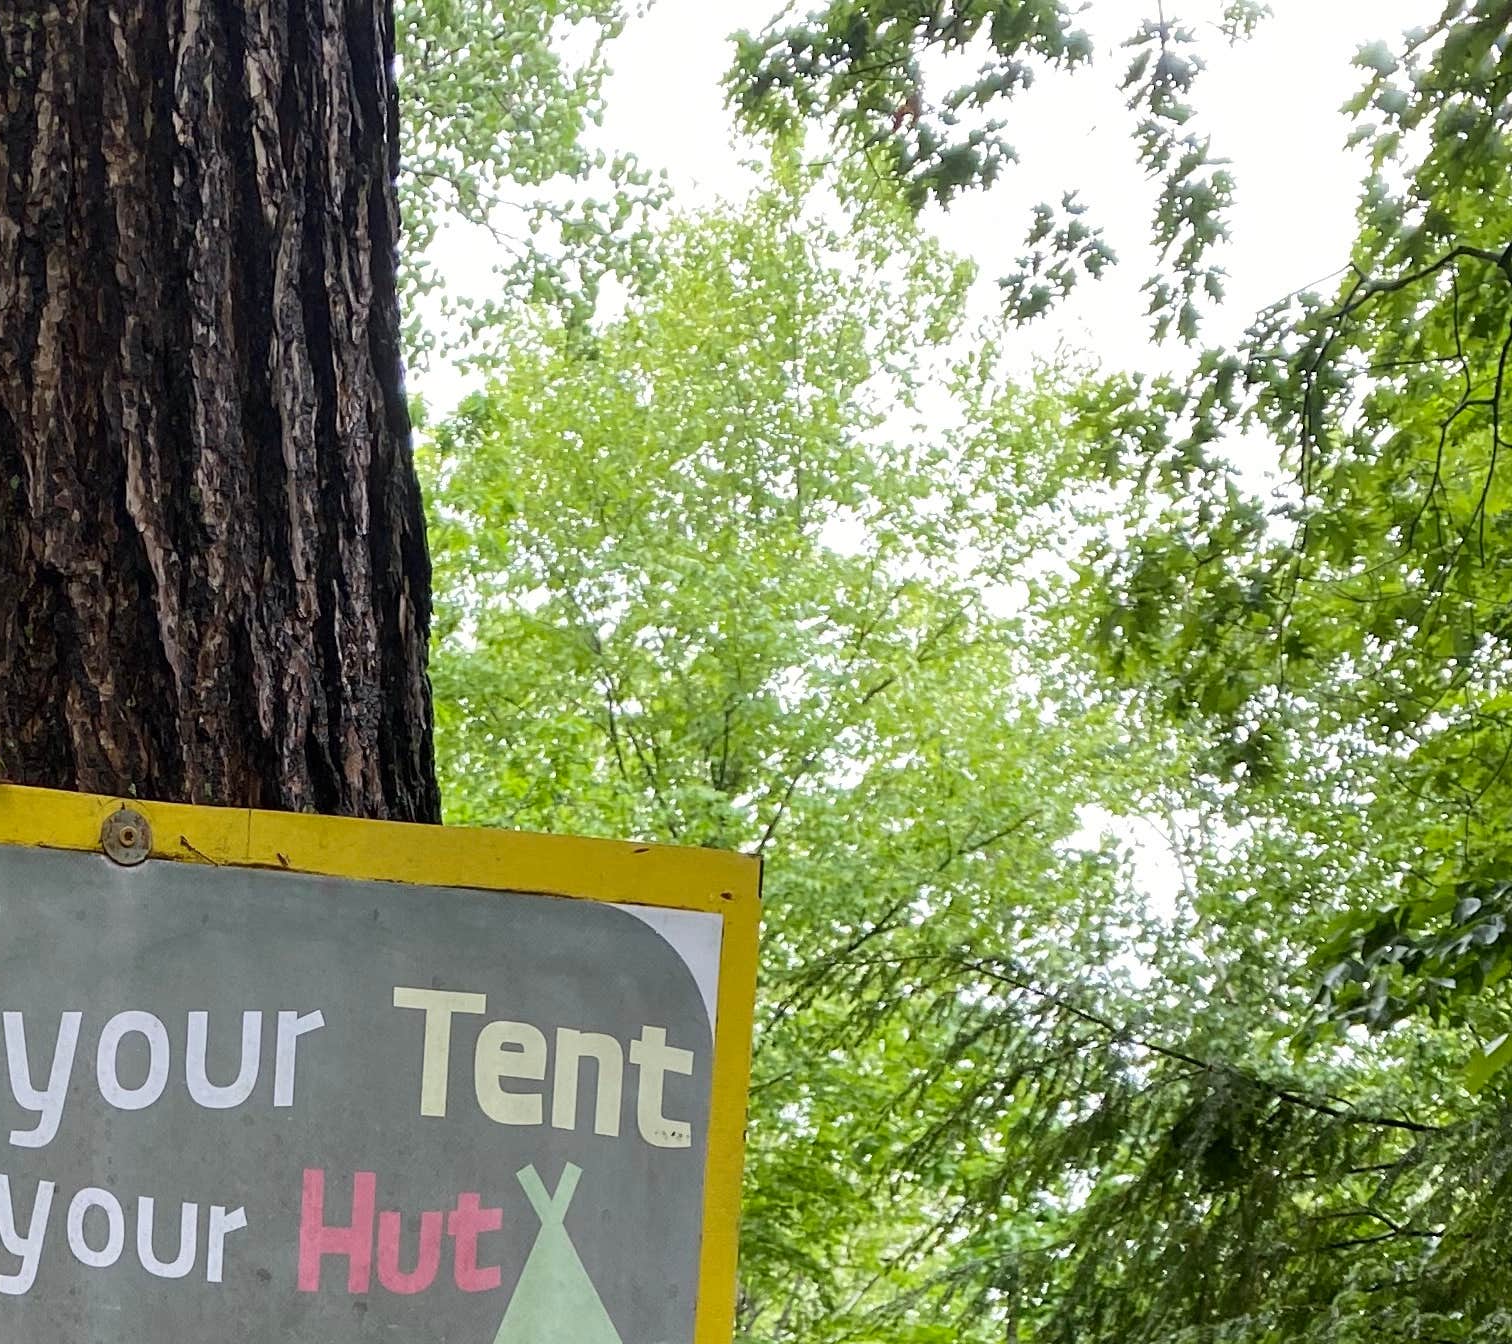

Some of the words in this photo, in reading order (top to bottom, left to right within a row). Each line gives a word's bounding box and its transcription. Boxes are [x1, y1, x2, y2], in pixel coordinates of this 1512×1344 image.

[2, 1009, 325, 1148] your
[393, 987, 694, 1148] Tent
[297, 1168, 504, 1295] Hut
